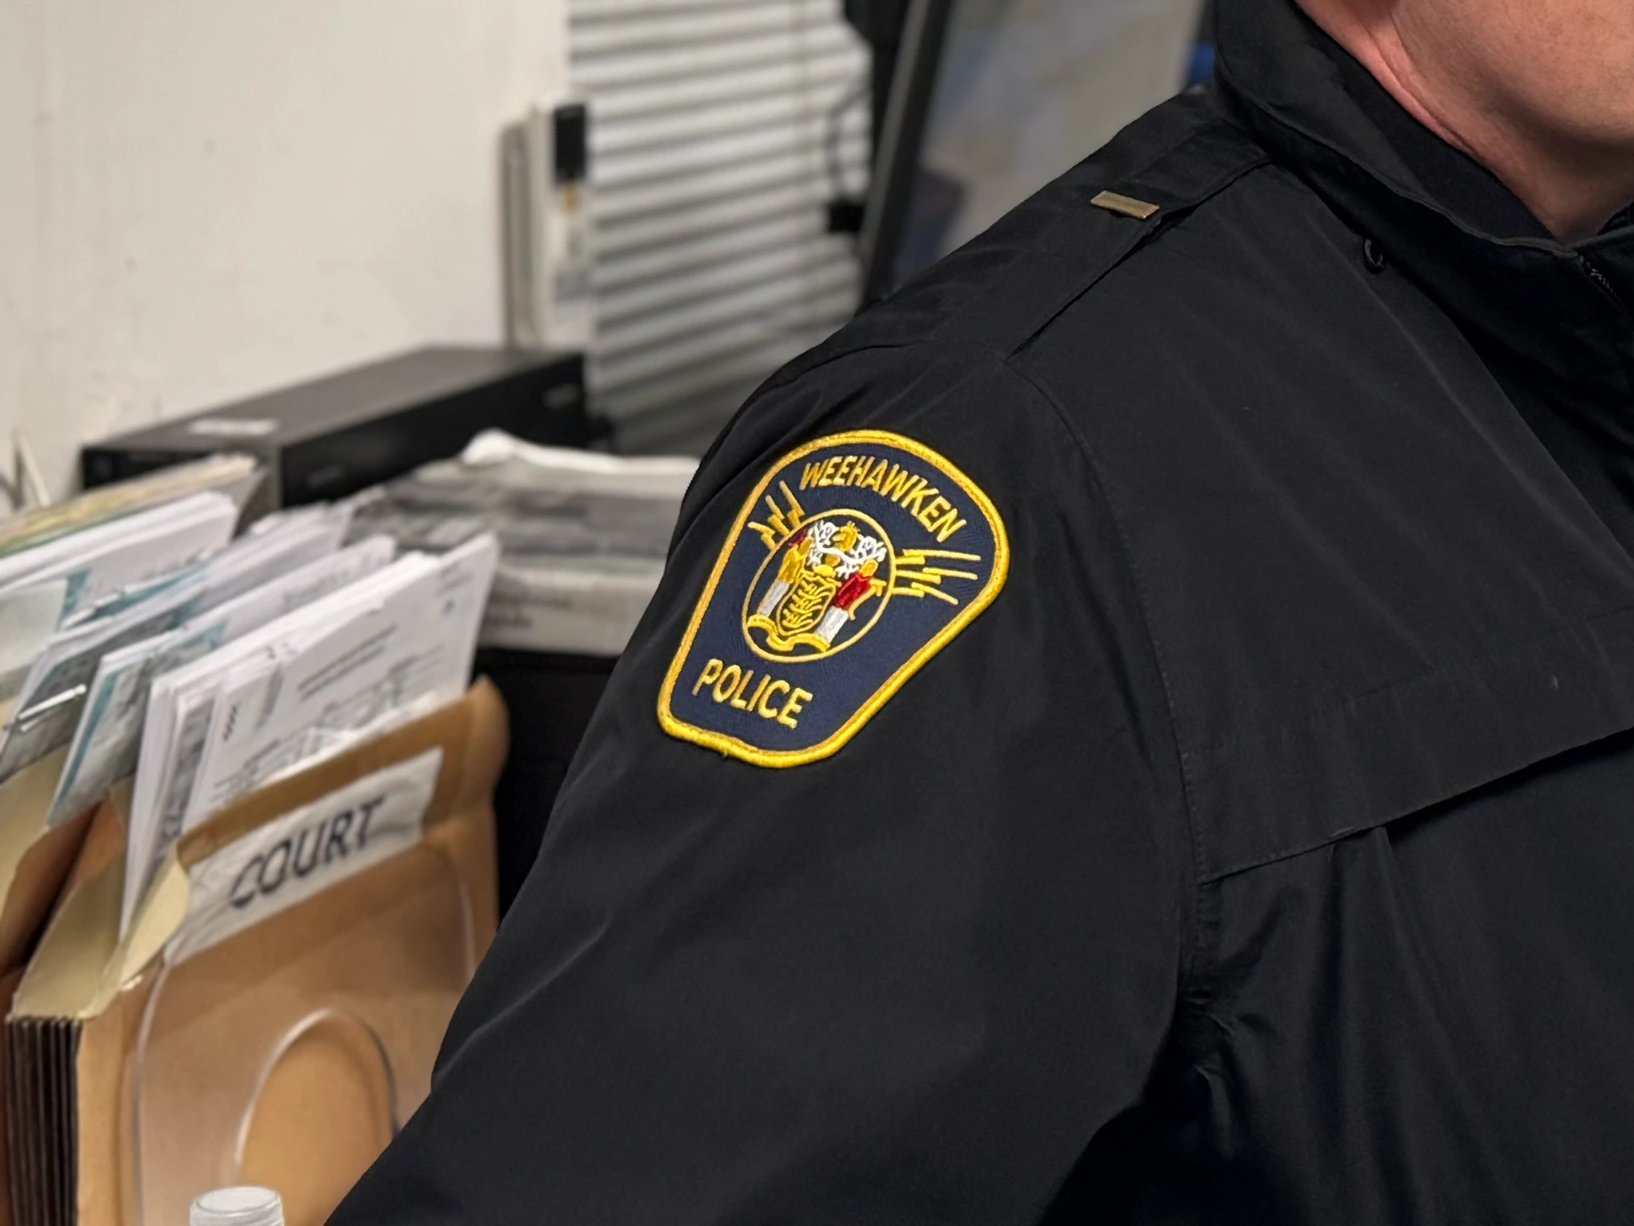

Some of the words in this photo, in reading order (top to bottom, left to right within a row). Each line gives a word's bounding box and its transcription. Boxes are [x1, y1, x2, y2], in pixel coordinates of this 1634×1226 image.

[800, 455, 966, 543] WEEHAWKEN
[692, 659, 813, 729] POLICE
[229, 793, 386, 909] COURT
